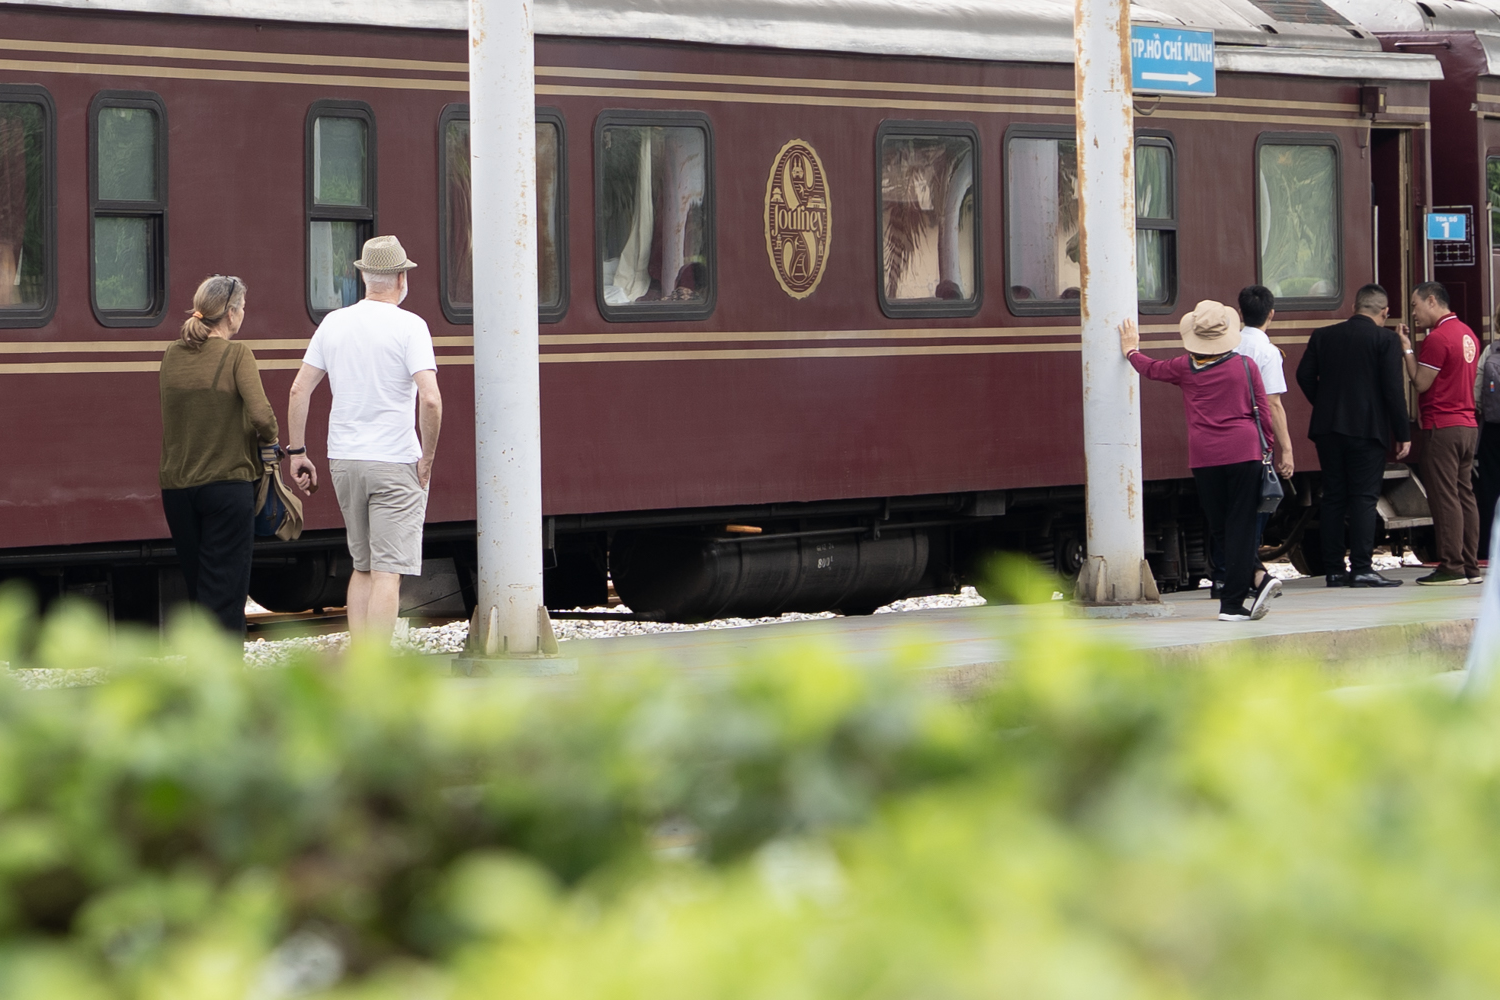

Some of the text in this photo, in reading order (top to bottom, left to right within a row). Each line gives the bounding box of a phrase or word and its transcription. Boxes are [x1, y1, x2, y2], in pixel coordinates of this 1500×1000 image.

[1163, 35, 1183, 61] CHÍ
[1184, 42, 1213, 63] MINH
[1441, 222, 1450, 238] 1
